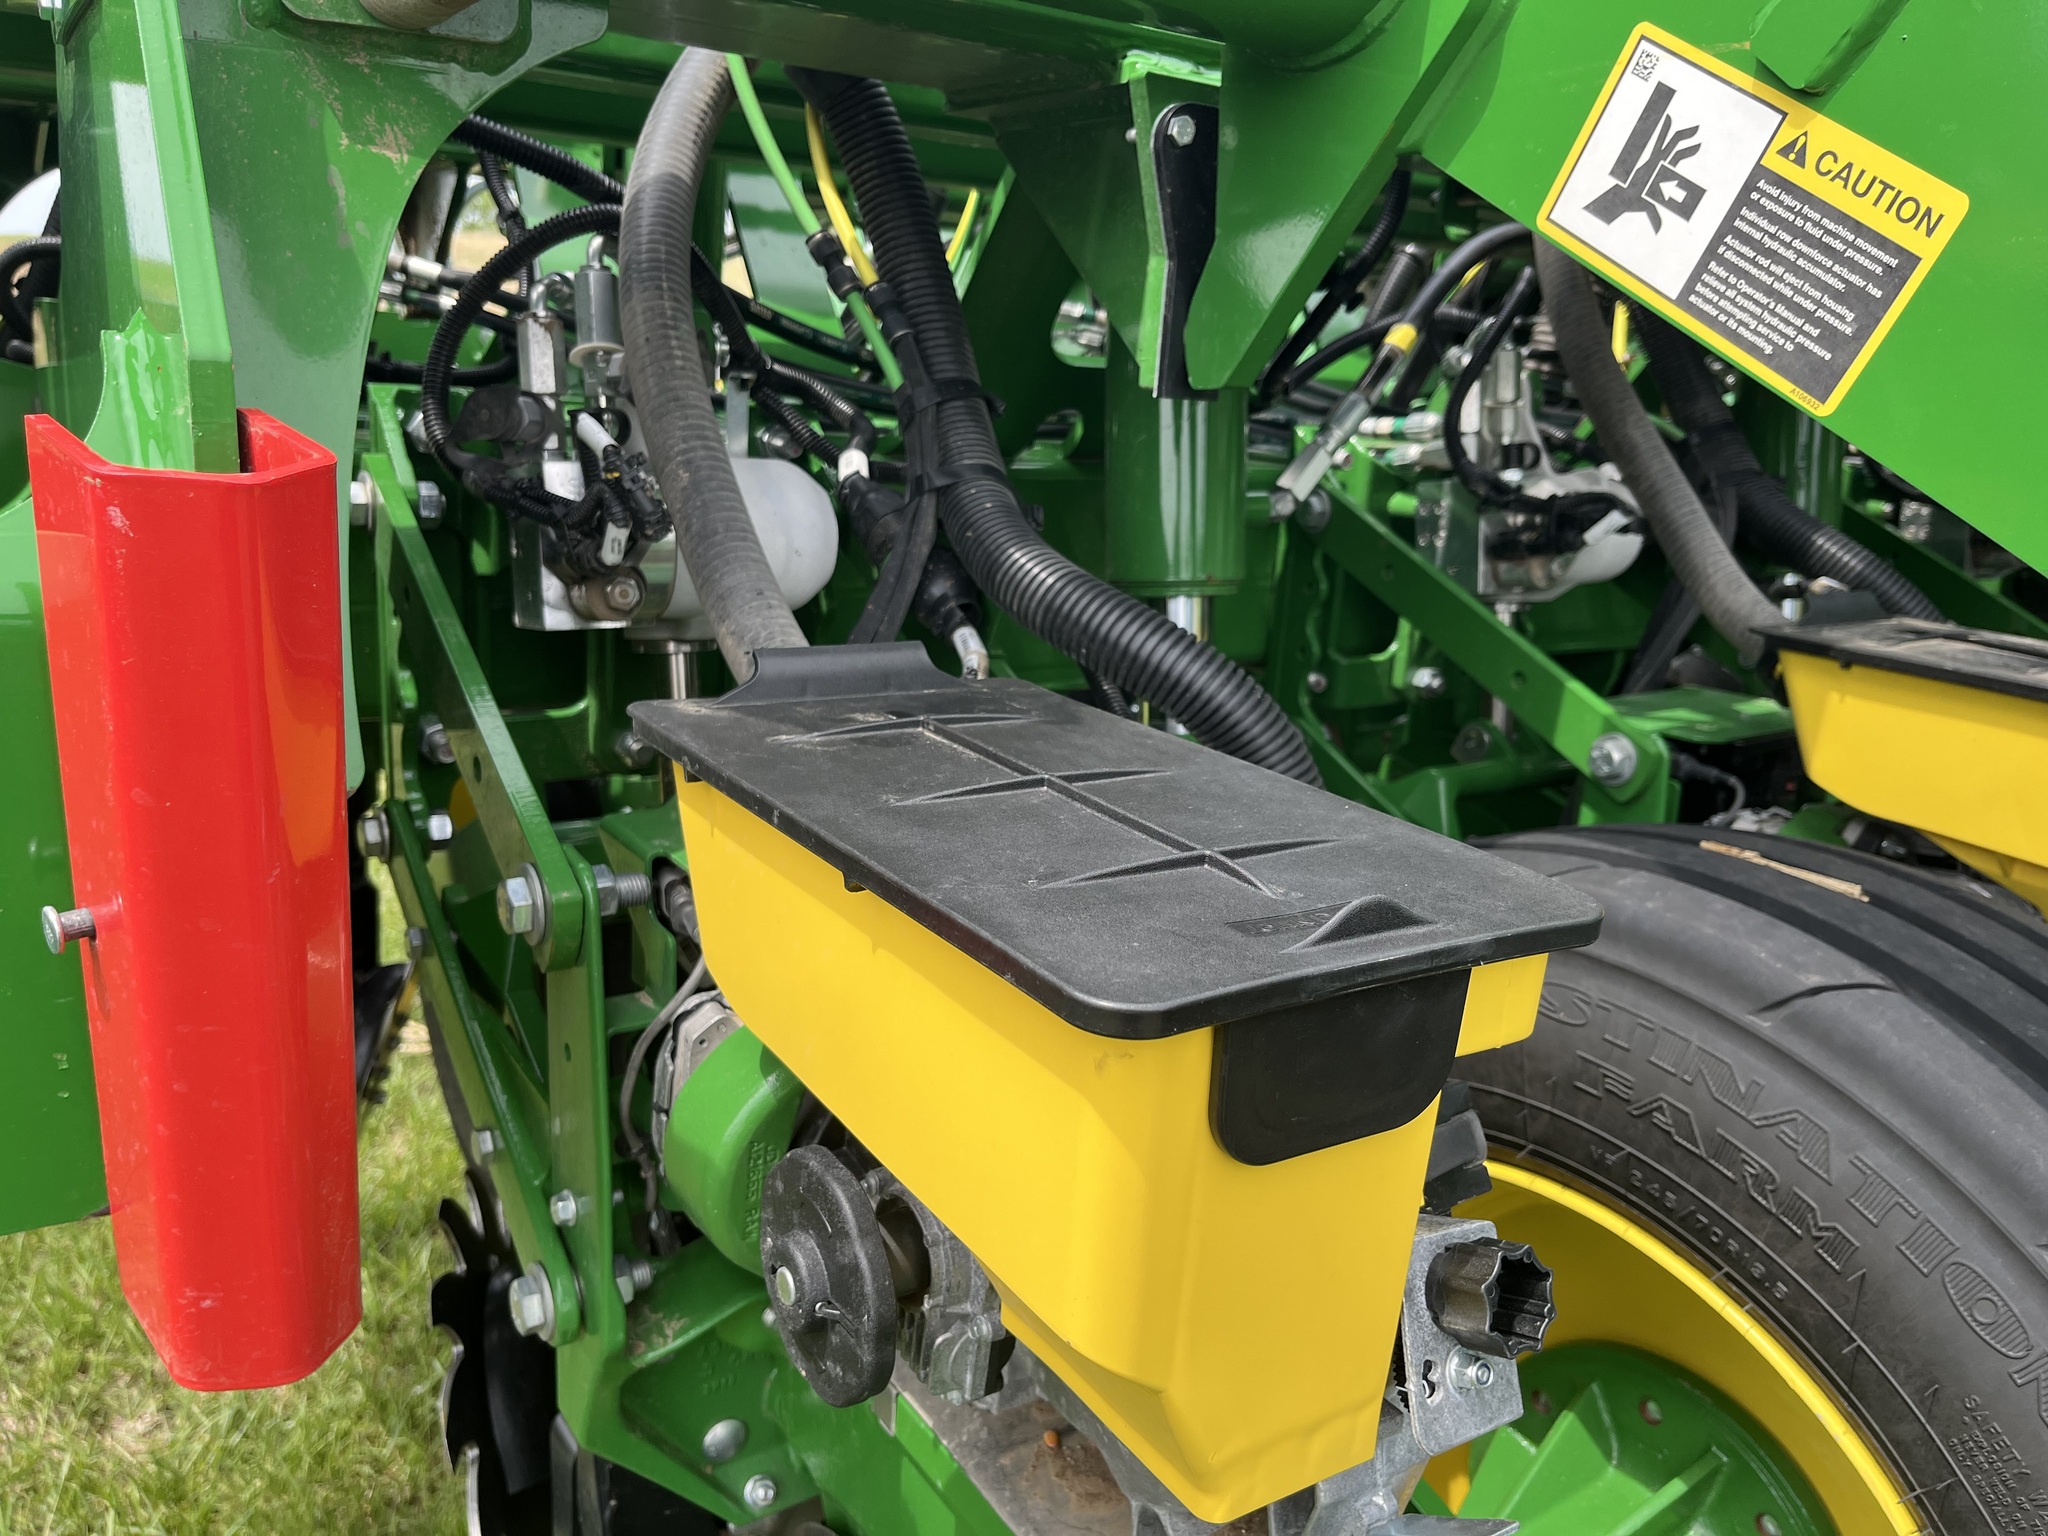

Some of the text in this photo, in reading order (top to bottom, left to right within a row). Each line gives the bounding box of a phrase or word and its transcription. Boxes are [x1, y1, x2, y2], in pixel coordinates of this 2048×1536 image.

[1750, 192, 1883, 276] or exposure to fluid under pressure.
[1756, 179, 1782, 198] Avoid
[1801, 205, 1822, 223] from
[1820, 218, 1856, 242] machine
[1854, 238, 1899, 268] movement
[1814, 150, 1945, 239] CAUTION
[1724, 235, 1856, 323] Actuator rod will eject from housing
[1724, 250, 1775, 286] disconnected
[1772, 281, 1795, 298] while
[1793, 294, 1818, 313] under
[1814, 308, 1853, 337] pressure.
[1740, 206, 1883, 299] Individual row downforce actuator has
[1761, 234, 1798, 262] hydraulic
[1796, 258, 1846, 293] accumulator.
[1688, 294, 1774, 355] actuator or its mounting.
[1695, 282, 1795, 352] before attempting service to
[1701, 273, 1832, 361] relieve all system hydraulic pressure
[1708, 261, 1822, 338] Refer to Operator's Manual and
[1573, 1050, 1860, 1272] FARM
[1948, 1438, 1973, 1467] ONLY
[1964, 1394, 2032, 1475] SAFETY
[2016, 1496, 2031, 1512] OF
